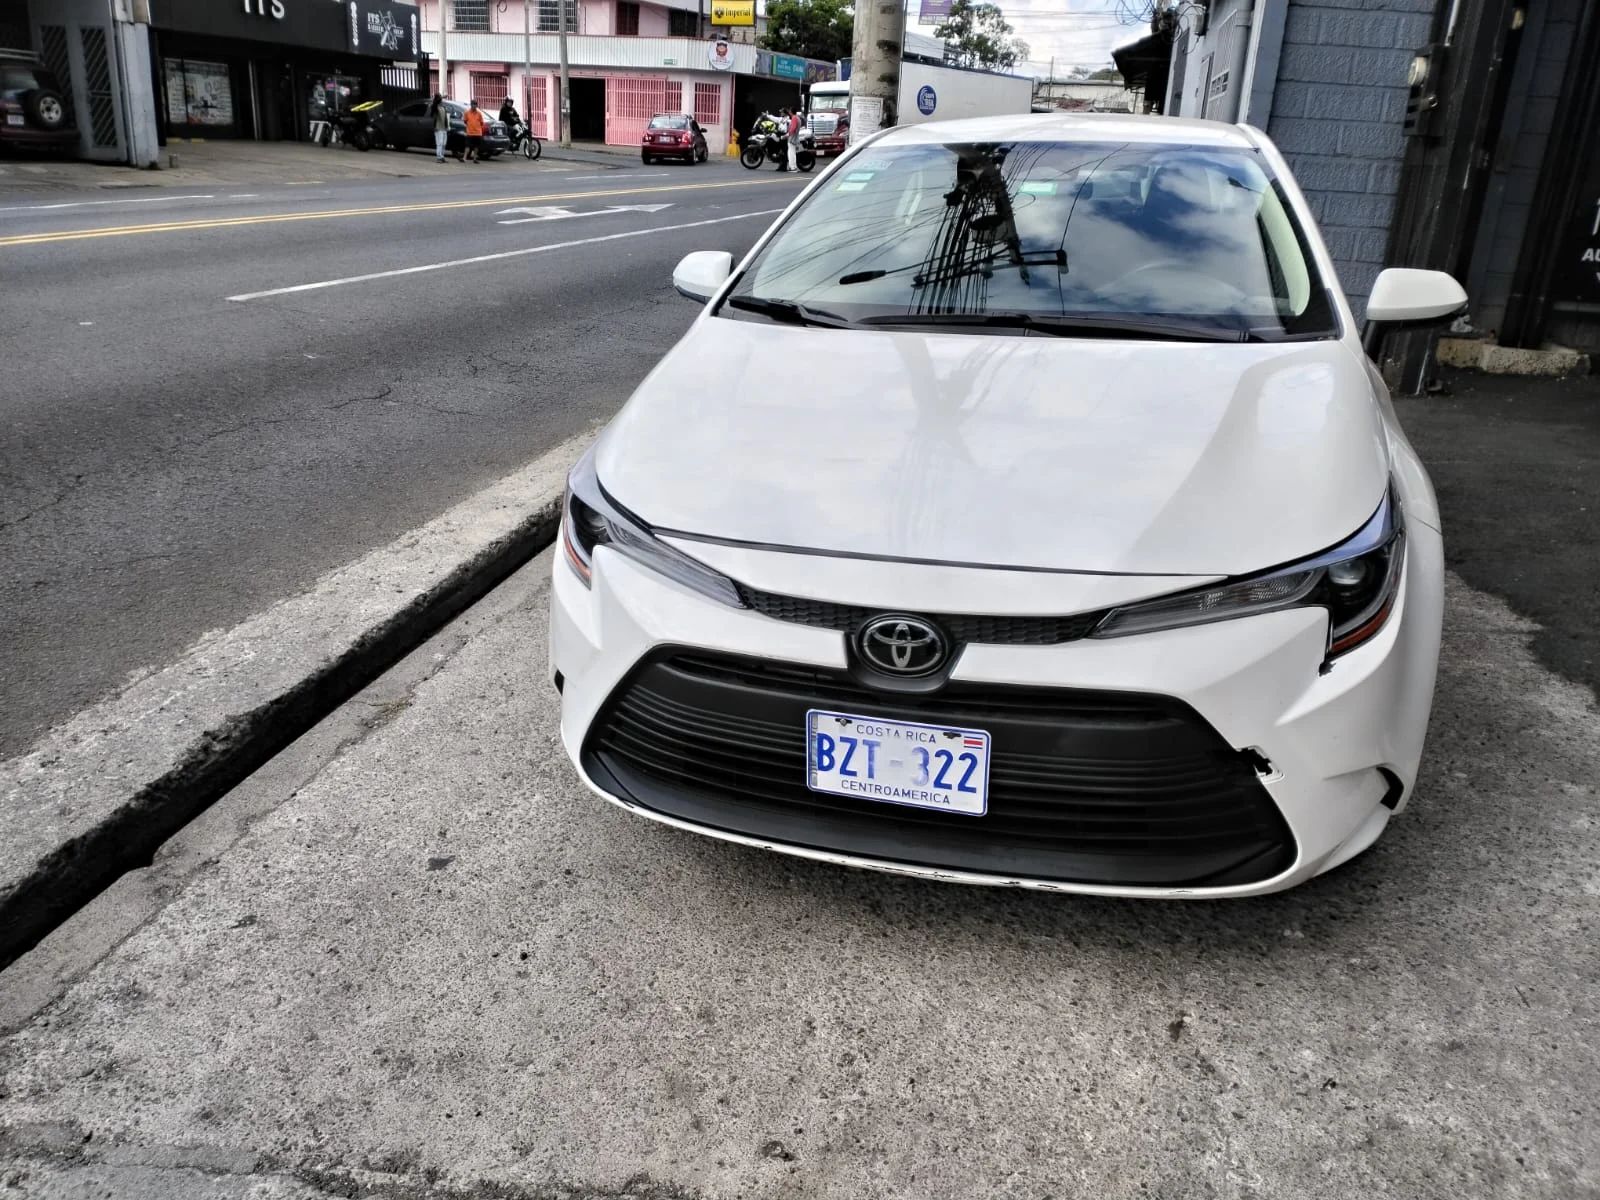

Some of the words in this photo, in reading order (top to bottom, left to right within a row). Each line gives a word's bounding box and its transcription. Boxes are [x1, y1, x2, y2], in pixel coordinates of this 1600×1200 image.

[725, 8, 751, 19] Imperial
[856, 724, 900, 737] COSTA
[906, 730, 937, 744] RICA
[841, 780, 950, 805] CENTROAMERICA
